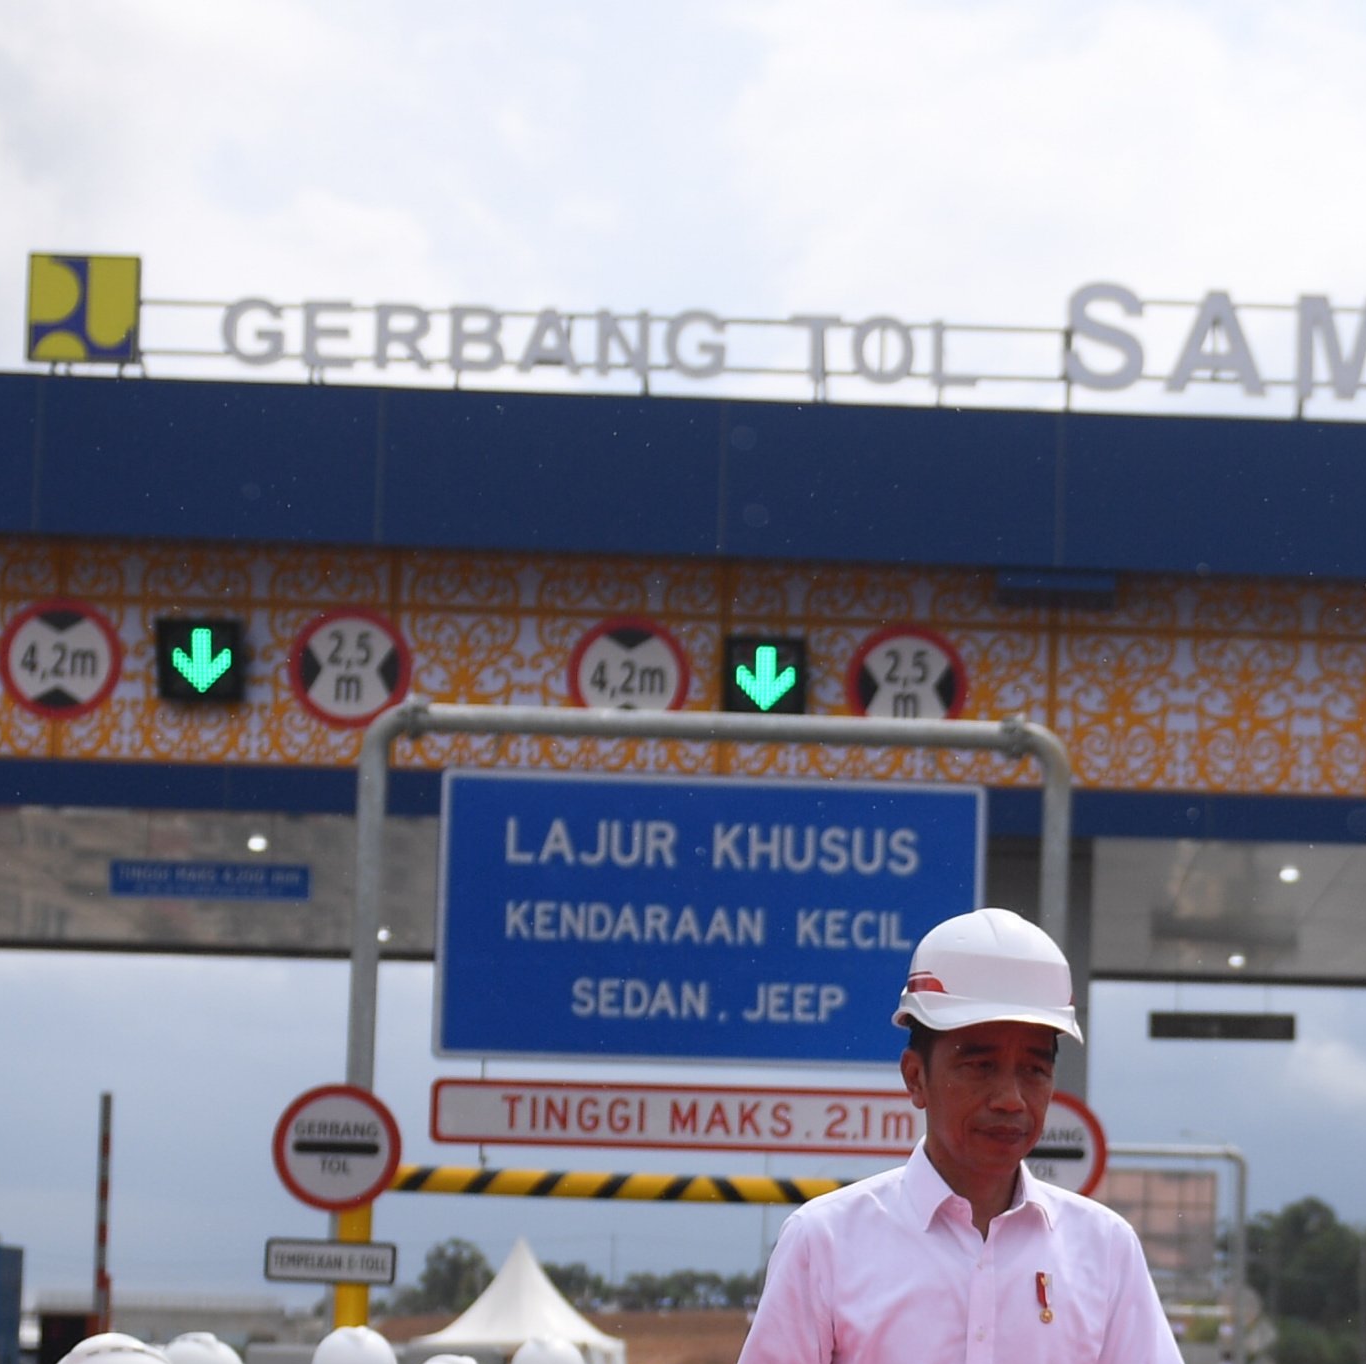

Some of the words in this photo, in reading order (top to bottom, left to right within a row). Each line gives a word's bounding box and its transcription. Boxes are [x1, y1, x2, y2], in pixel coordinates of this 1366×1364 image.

[220, 297, 727, 379] GERBANG
[788, 313, 978, 388] TOL
[20, 641, 98, 682] 4,2m
[328, 629, 372, 670] 2,5
[884, 648, 929, 688] 2,5
[334, 674, 362, 702] m
[590, 659, 667, 700] 4,2m
[504, 815, 678, 868] LAJUR
[711, 822, 921, 876] KHUSUS
[504, 899, 767, 946] KENDARAAN
[795, 907, 912, 950] KECIL
[742, 982, 847, 1024] JEEP
[294, 1119, 380, 1138] GERBANG
[502, 1094, 646, 1134] TINGGI
[319, 1157, 351, 1175] TOL
[273, 1251, 343, 1270] TEMPELKAN
